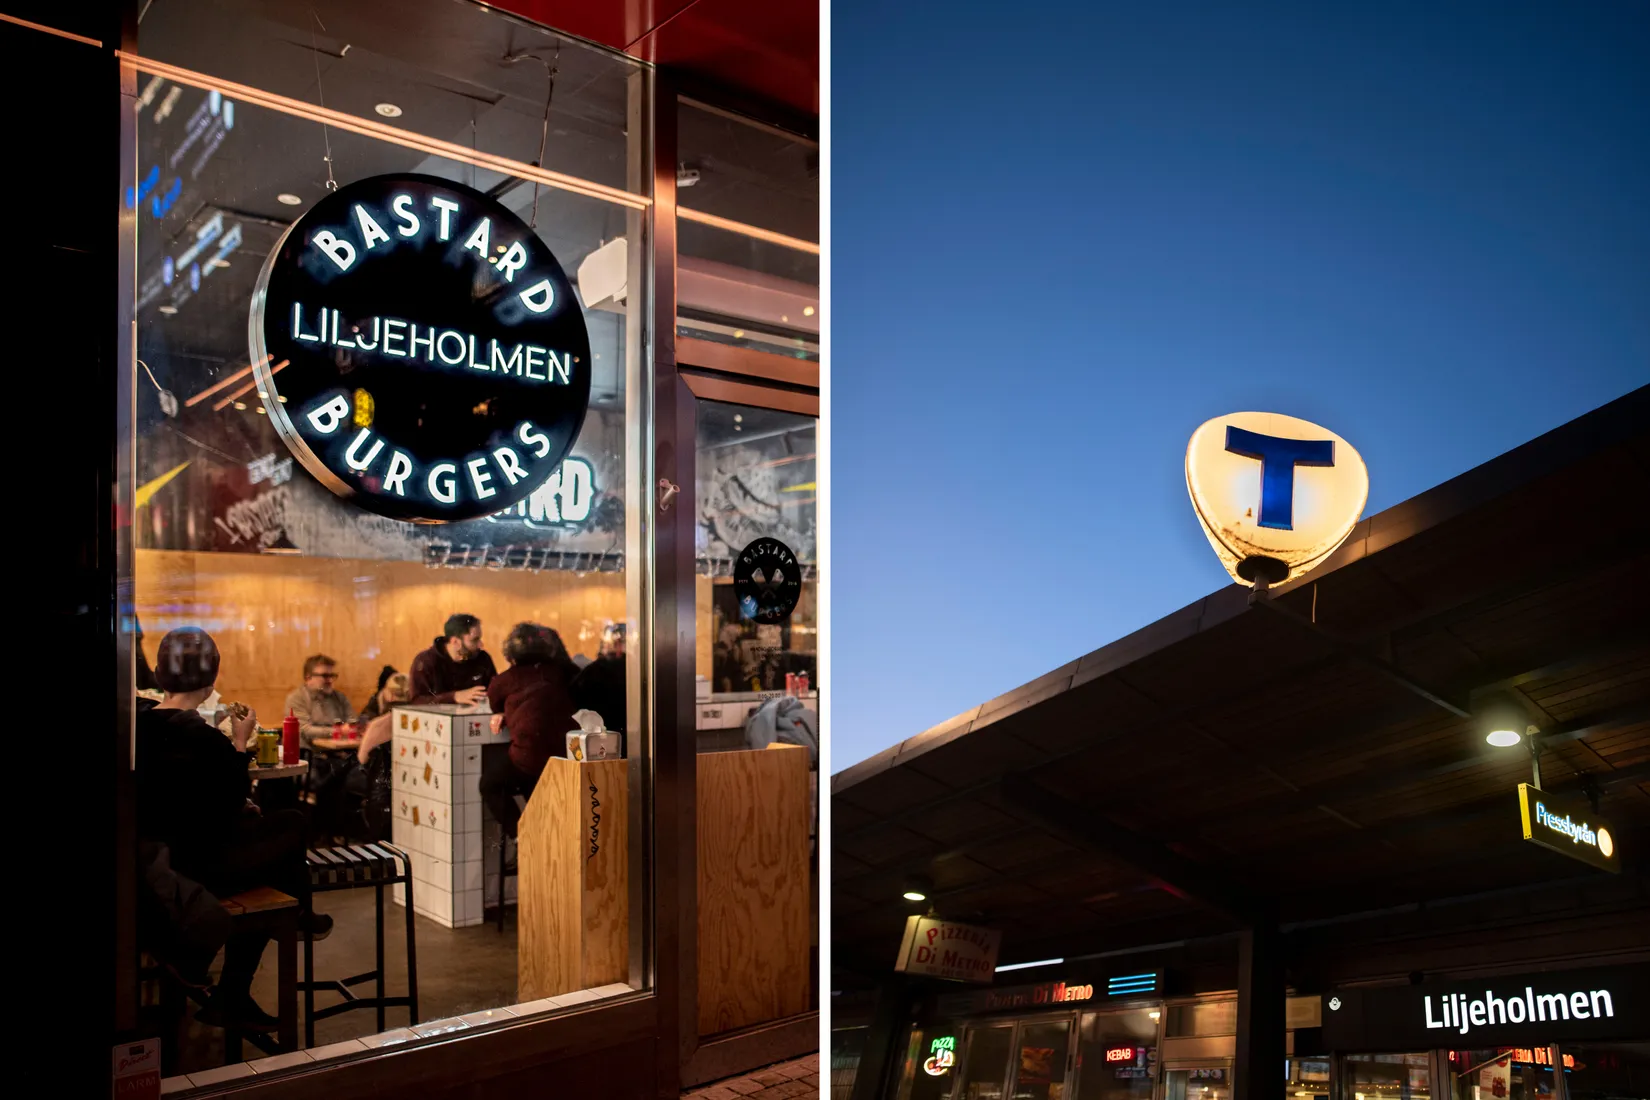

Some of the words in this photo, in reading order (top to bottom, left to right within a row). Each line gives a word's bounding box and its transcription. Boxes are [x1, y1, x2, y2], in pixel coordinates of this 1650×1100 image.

[312, 196, 554, 313] BASTARD
[294, 302, 570, 385] LILJEHOLMEN
[306, 394, 551, 504] BURGERS
[1224, 425, 1335, 531] T
[1536, 801, 1596, 846] Pressbyrån
[916, 946, 937, 964] Di
[1051, 982, 1094, 1003] METRO
[1424, 987, 1614, 1034] Liljeholmen
[1105, 1048, 1131, 1062] KEBAB
[117, 1076, 156, 1095] LARM
